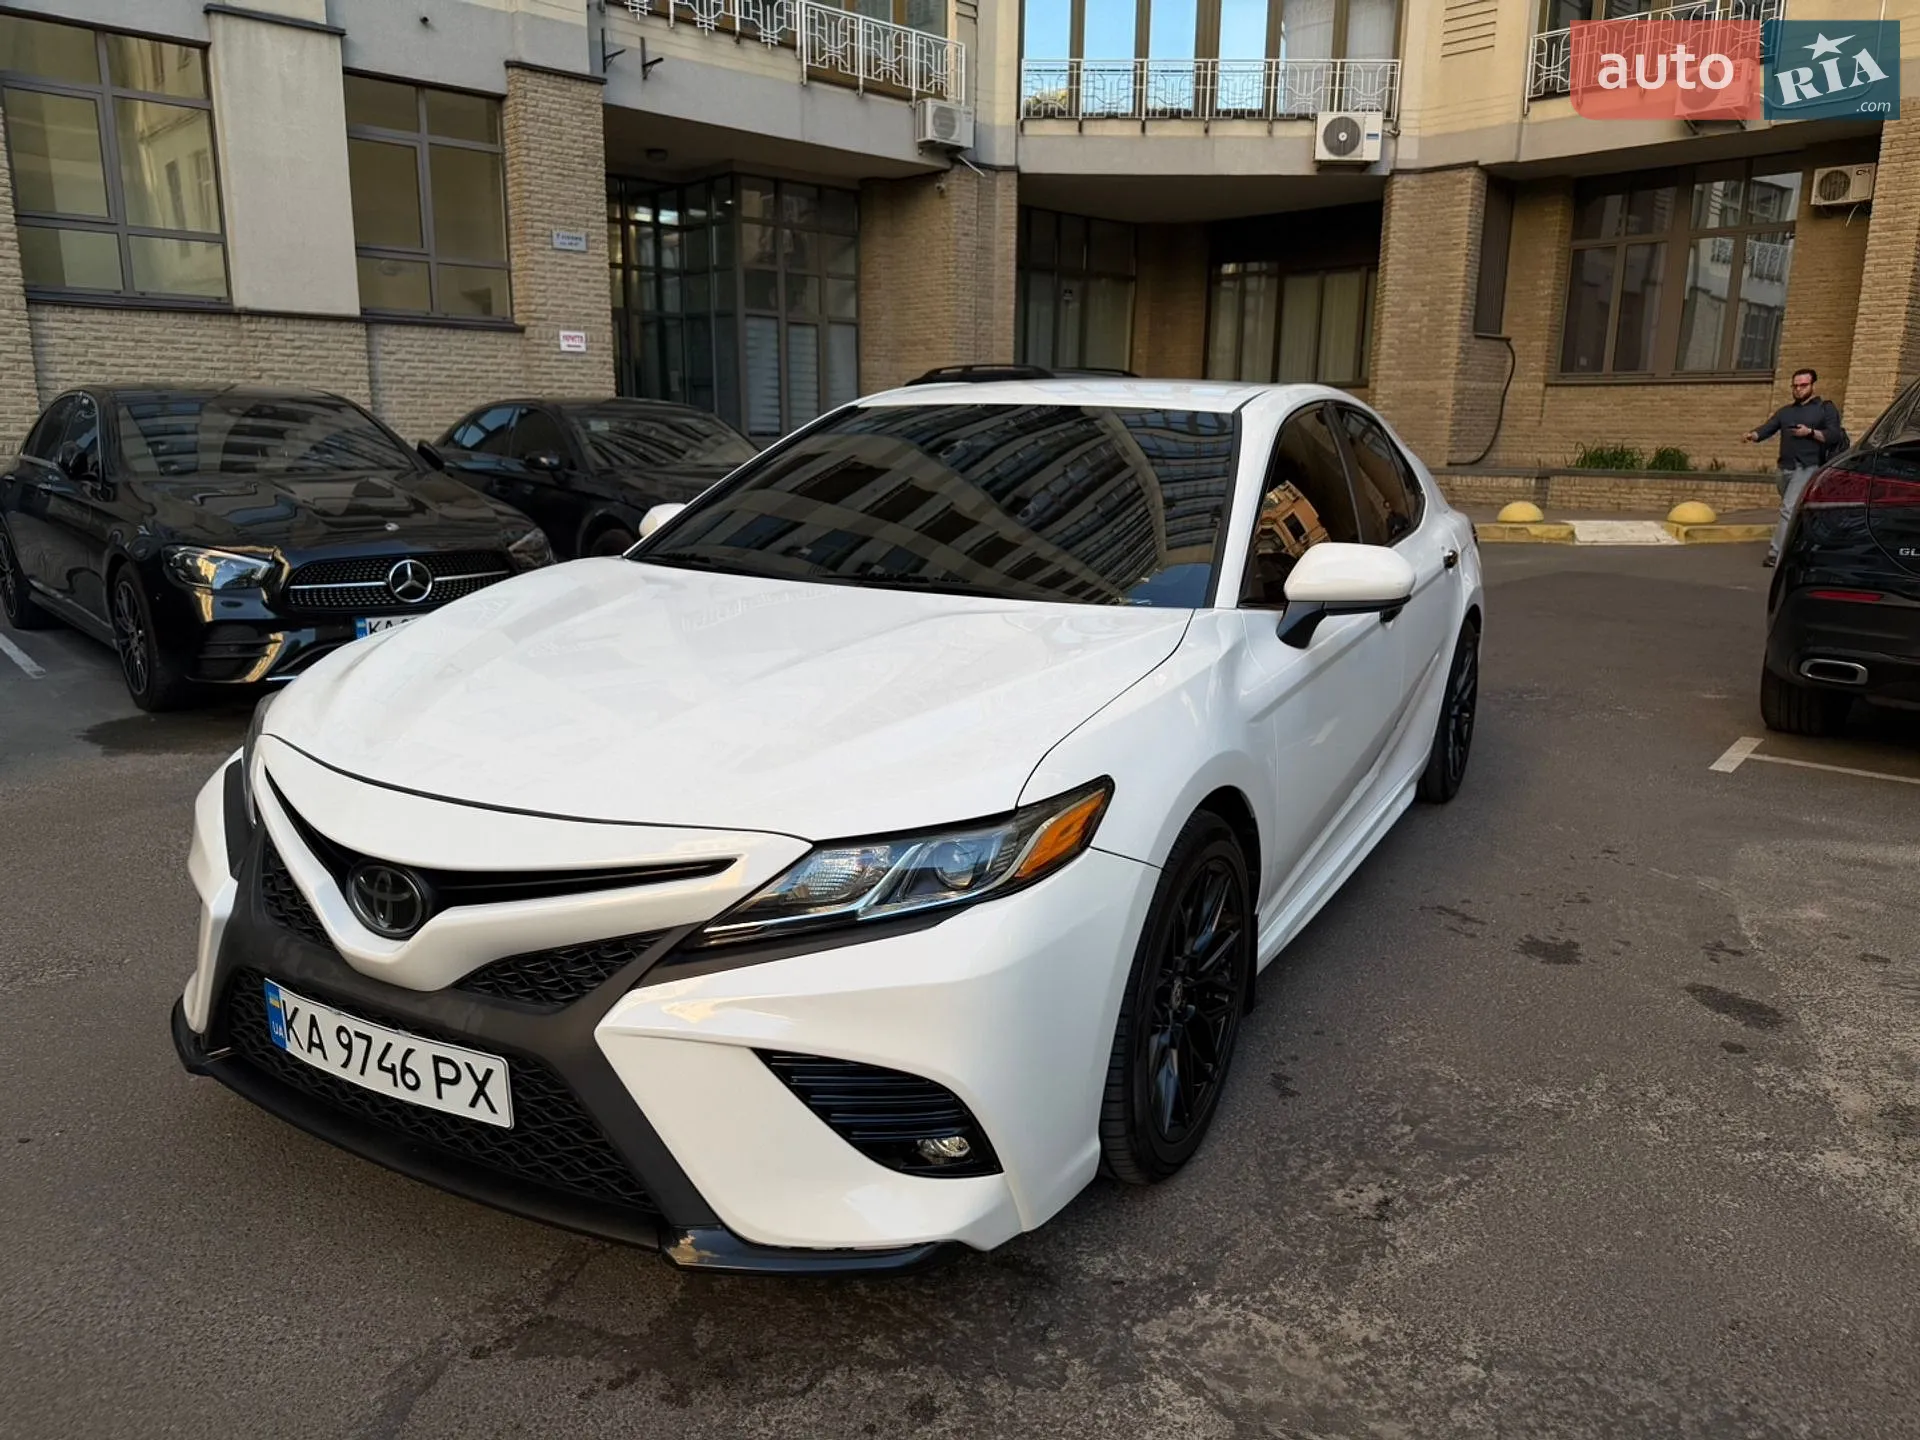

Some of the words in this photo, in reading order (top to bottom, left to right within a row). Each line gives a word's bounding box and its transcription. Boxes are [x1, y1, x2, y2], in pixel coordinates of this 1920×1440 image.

[282, 999, 329, 1062] KA
[335, 1025, 422, 1092] 9746
[431, 1054, 499, 1115] PX
